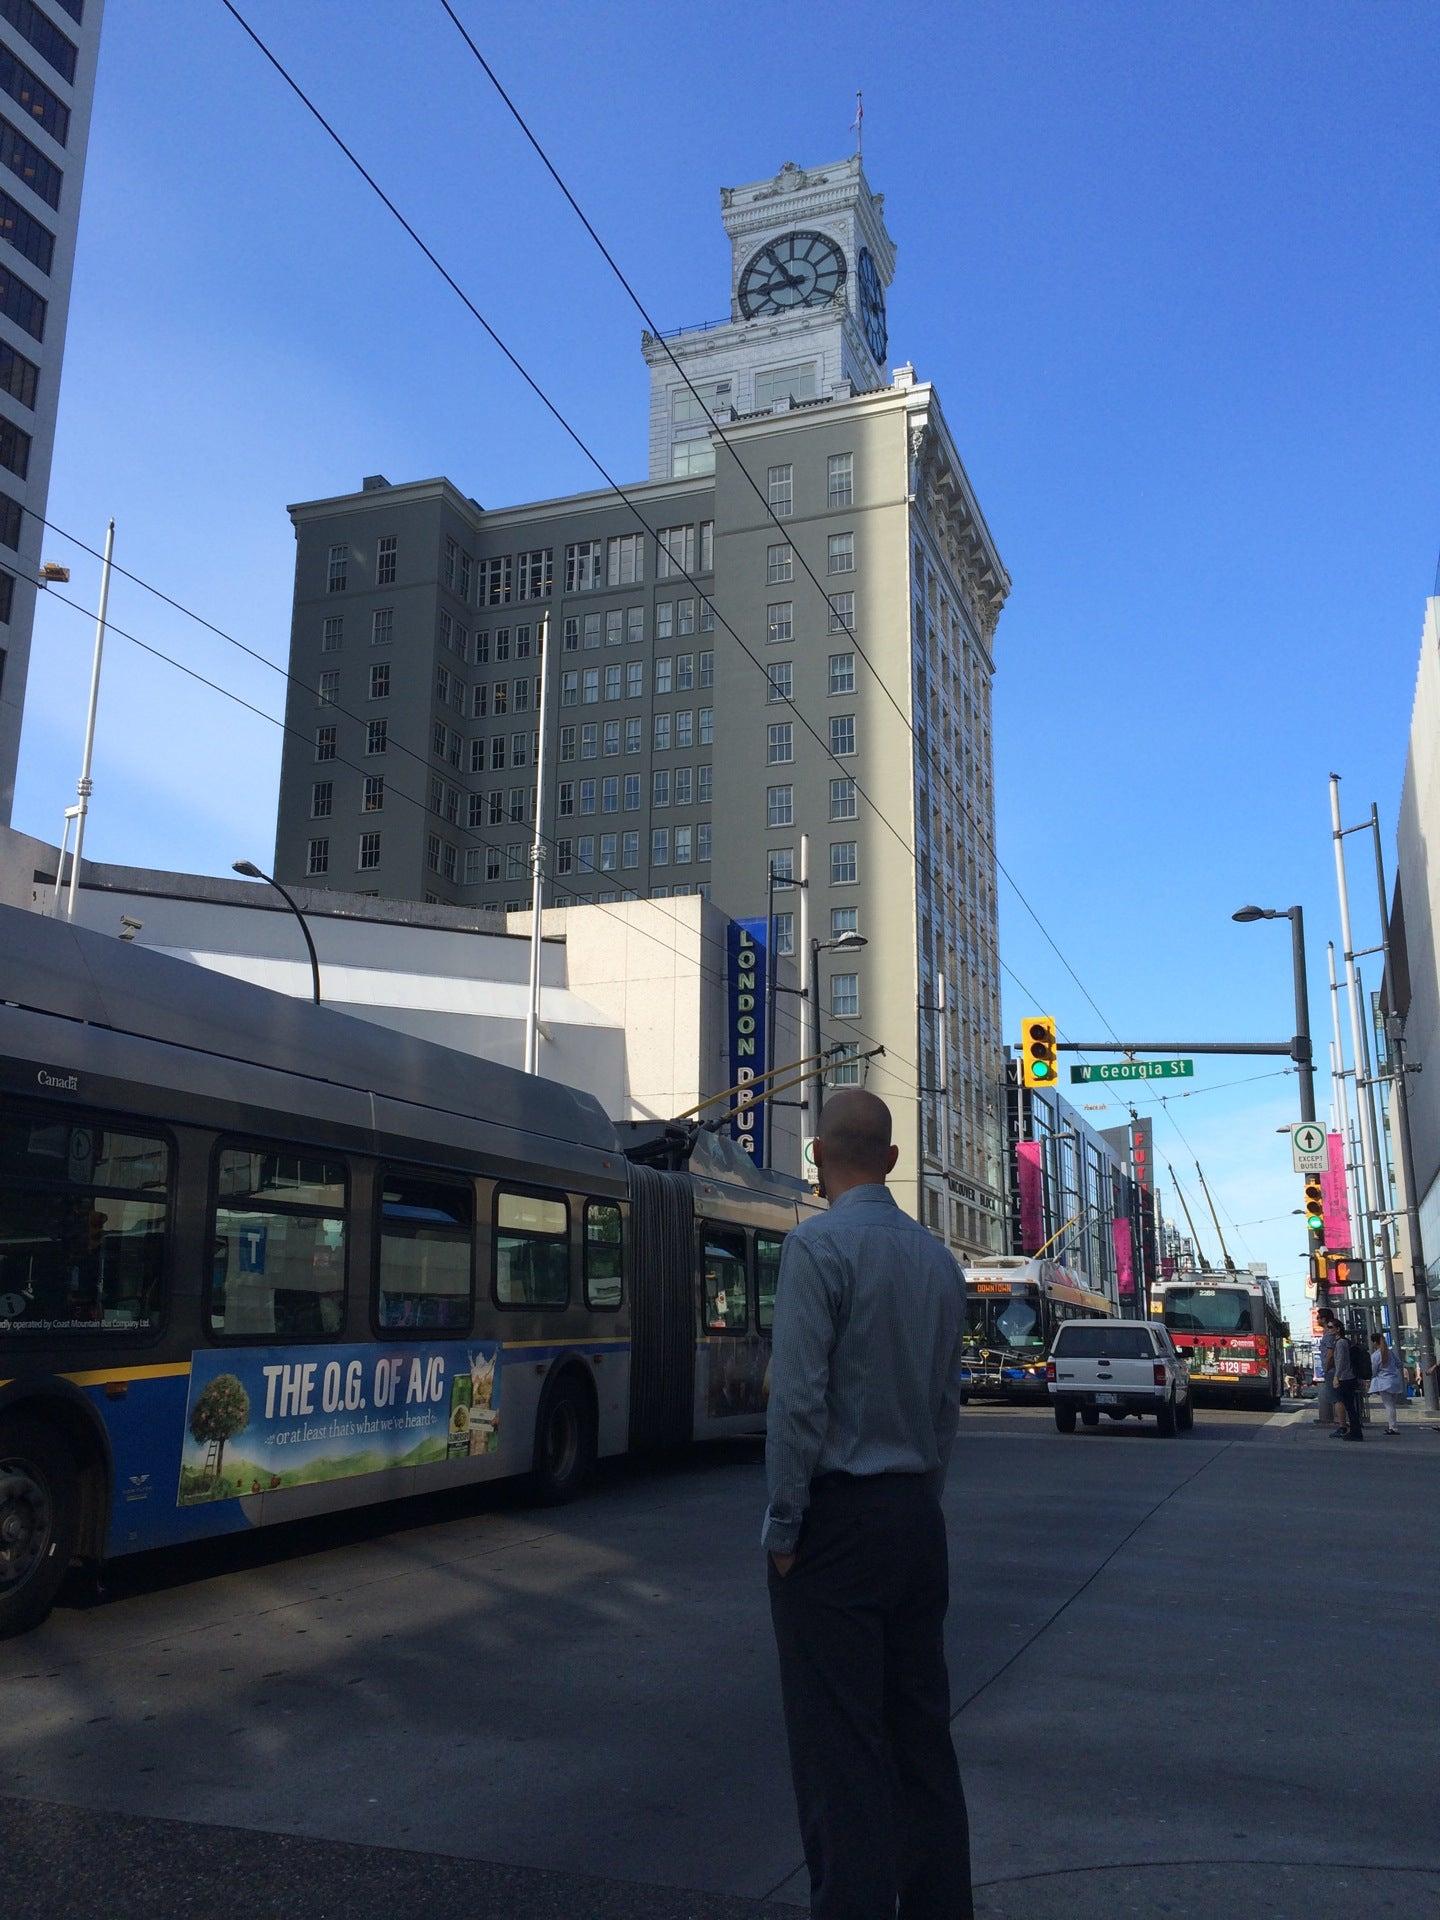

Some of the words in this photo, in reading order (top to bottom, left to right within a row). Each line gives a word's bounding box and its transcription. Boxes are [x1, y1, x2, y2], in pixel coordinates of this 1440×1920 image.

[737, 930, 756, 1056] LONDON
[1080, 1066, 1091, 1080] W
[1100, 1062, 1163, 1080] Georgia
[1170, 1060, 1186, 1074] St
[37, 1070, 78, 1091] Canada
[1298, 1155, 1323, 1163] EXCEPT
[1300, 1162, 1323, 1170] BUSES
[977, 1283, 1012, 1293] DOWNTOWN
[13, 1319, 42, 1329] operated
[43, 1319, 52, 1330] by
[53, 1320, 70, 1328] Coast
[71, 1319, 100, 1328] Mountain
[101, 1320, 112, 1328] Bus
[112, 1319, 139, 1330] Company
[1220, 1361, 1239, 1373] $129
[262, 1363, 318, 1419] THE
[322, 1360, 366, 1413] O.G.
[373, 1358, 403, 1408] OF
[405, 1356, 445, 1404] A/C
[276, 1432, 291, 1445] or
[290, 1430, 301, 1443] at
[303, 1422, 327, 1441] least
[328, 1419, 354, 1438] that's
[356, 1415, 380, 1434] what
[381, 1418, 403, 1431] we've
[404, 1408, 431, 1428] heard
